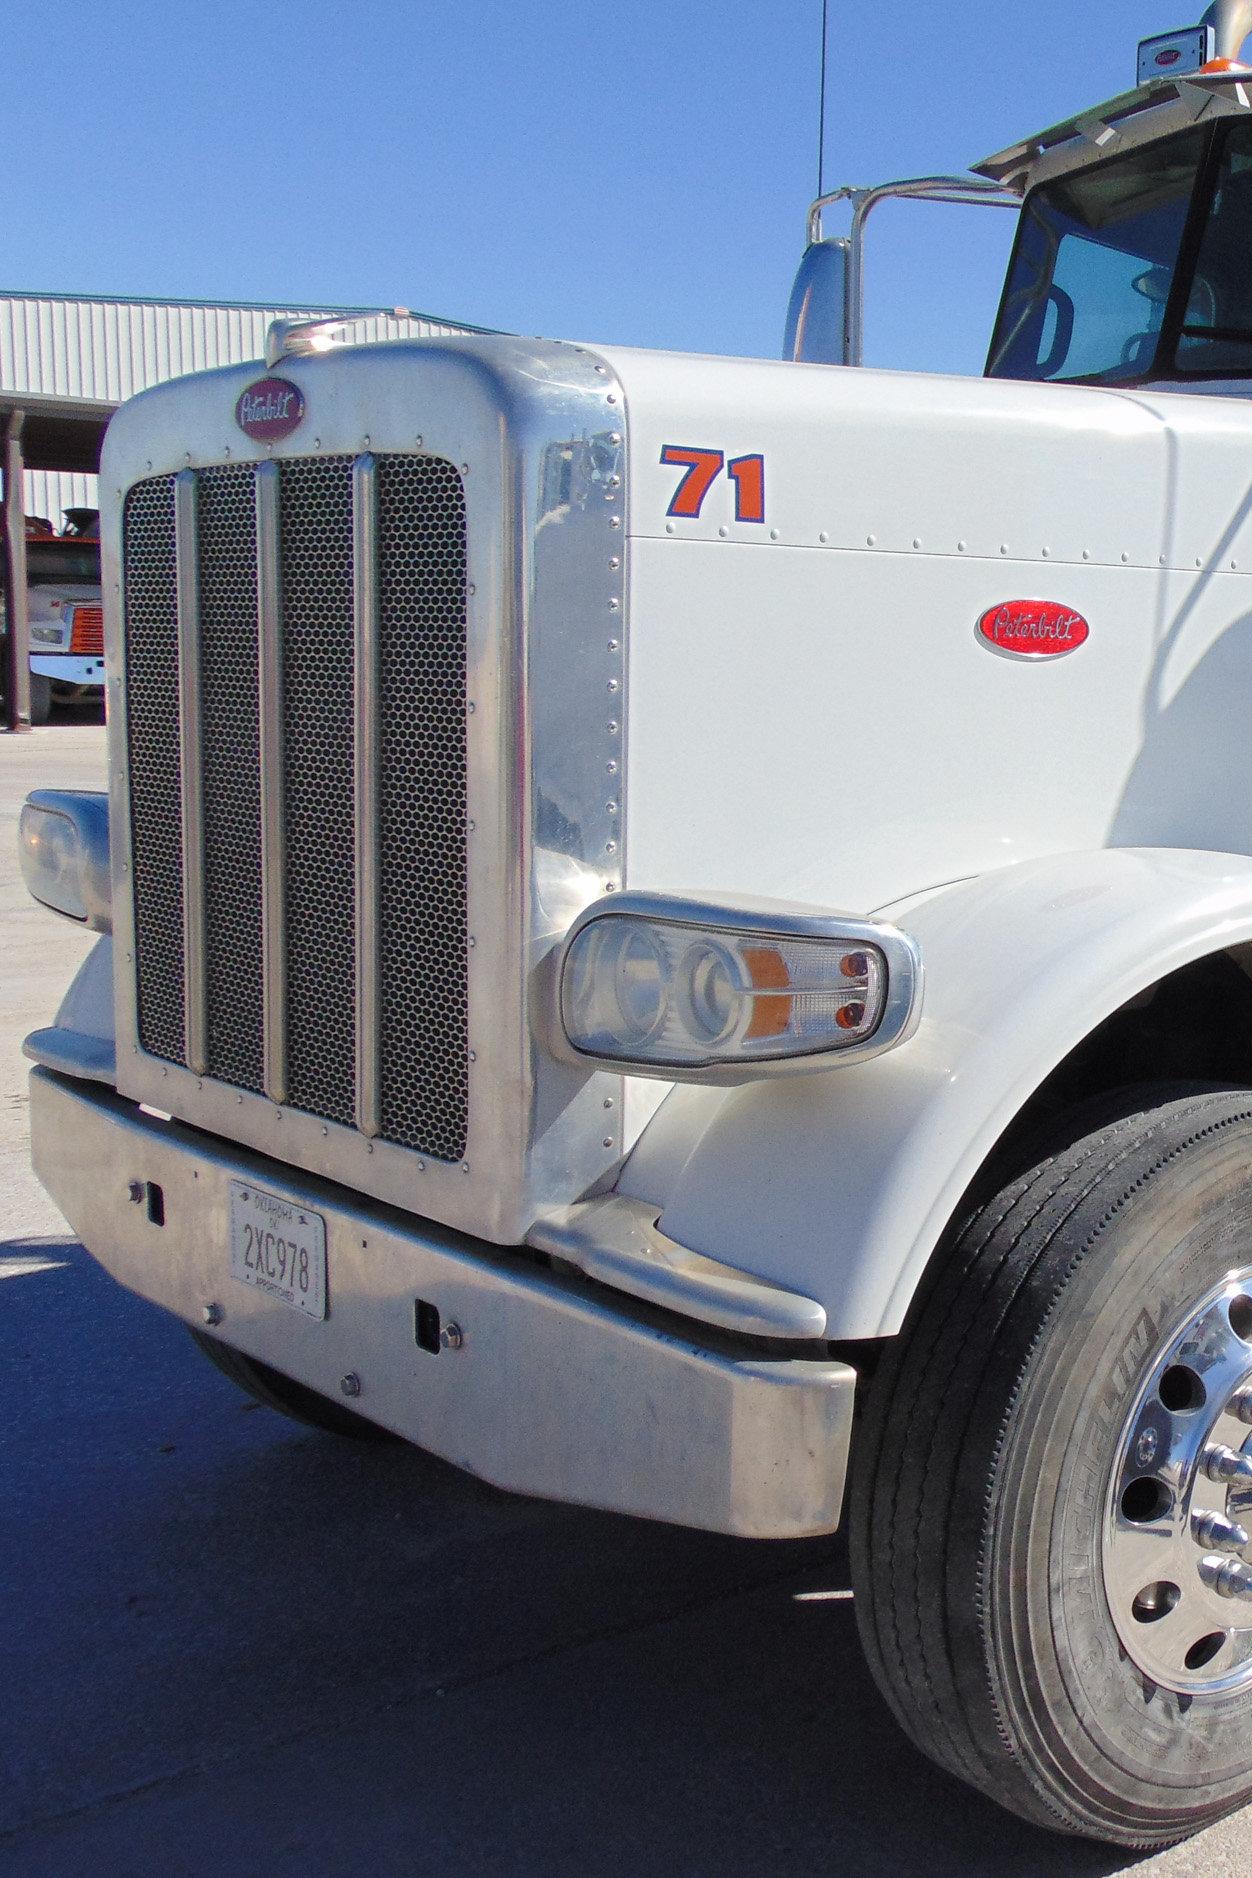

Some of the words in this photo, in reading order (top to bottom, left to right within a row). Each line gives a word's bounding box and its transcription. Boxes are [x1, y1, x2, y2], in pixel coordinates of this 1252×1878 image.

[241, 391, 294, 426] Peterbilt
[659, 444, 765, 524] 71
[992, 606, 1080, 640] Peterbilt
[244, 1222, 309, 1293] 2XC978
